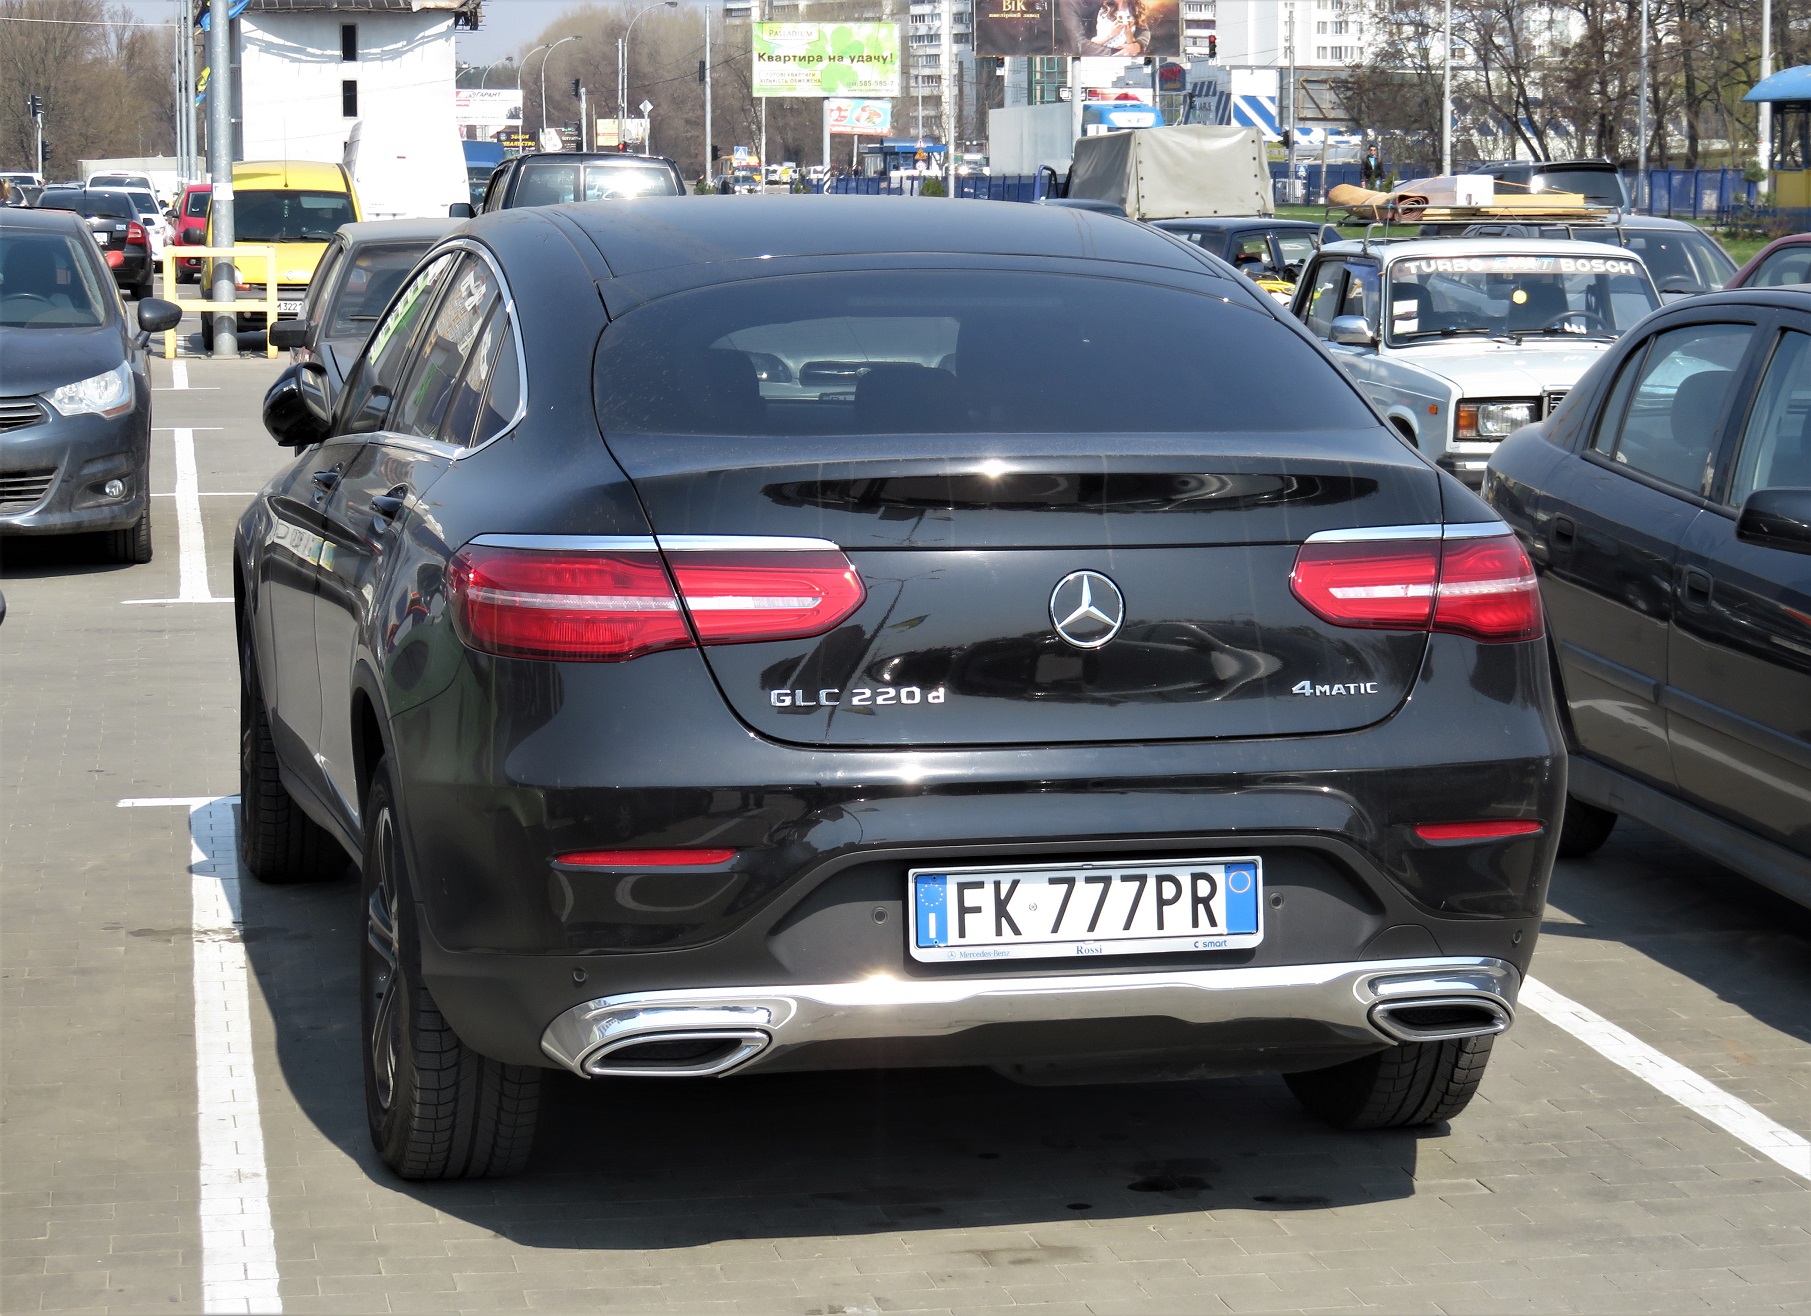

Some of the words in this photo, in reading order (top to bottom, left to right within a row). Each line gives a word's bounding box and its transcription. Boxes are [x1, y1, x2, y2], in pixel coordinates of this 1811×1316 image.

[768, 29, 813, 37] PALLADIUM
[757, 52, 823, 64] Квартира
[828, 54, 844, 63] на
[848, 52, 894, 64] удачу!
[1404, 258, 1486, 274] TURBO
[1559, 258, 1636, 274] BOSCH
[1291, 680, 1379, 697] 4MATIC
[769, 688, 840, 707] GLC
[1076, 944, 1103, 955] Rossi
[1202, 939, 1228, 949] smart
[959, 949, 1010, 959] Mercedes-Benz
